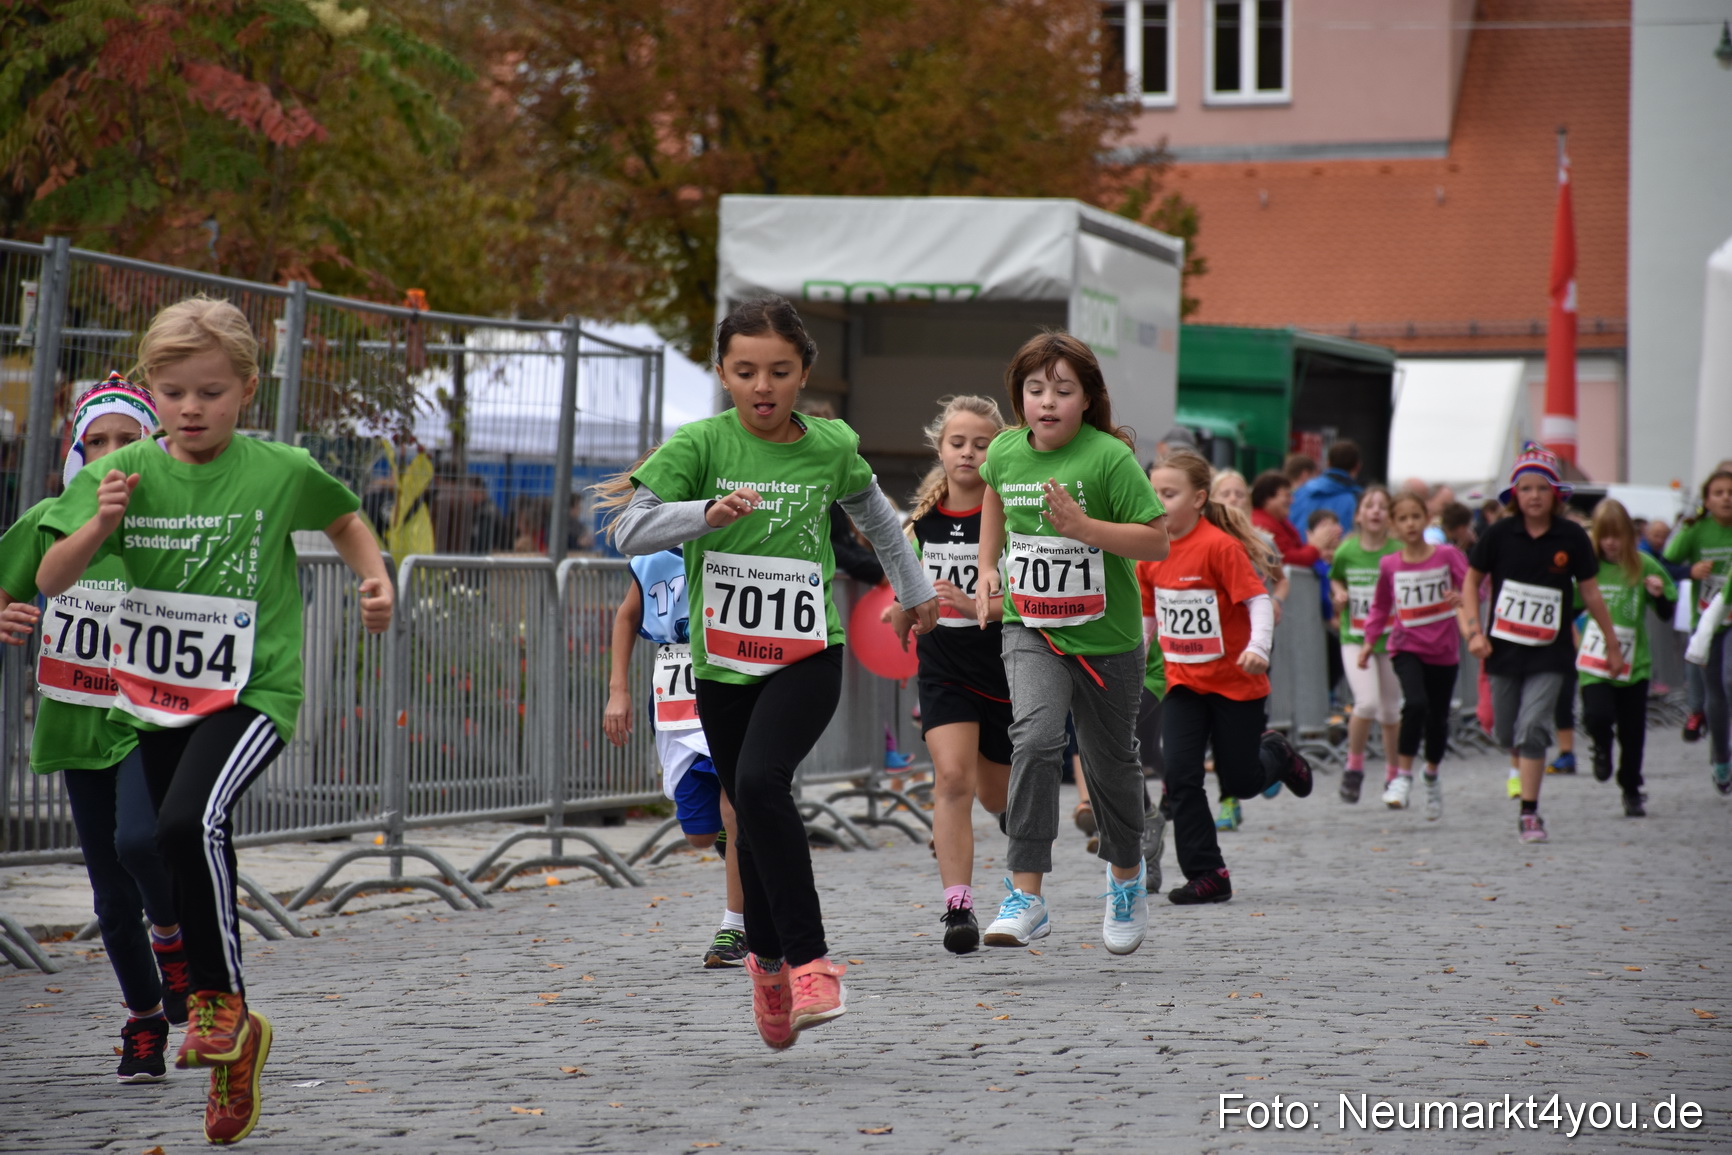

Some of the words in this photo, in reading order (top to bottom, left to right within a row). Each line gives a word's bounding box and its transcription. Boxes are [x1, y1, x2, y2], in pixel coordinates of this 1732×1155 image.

[716, 477, 802, 494] Neumarkter
[124, 514, 222, 530] Neumarkter
[124, 534, 202, 552] Stadtlauf
[246, 509, 263, 597] BAMBINI
[1036, 546, 1084, 555] Neumarkt
[924, 551, 946, 561] PARTL
[705, 563, 744, 579] PARTL
[747, 568, 805, 583] Neumarkt
[928, 564, 980, 594] 742
[1015, 556, 1091, 592] 7071
[51, 595, 82, 609] ARTL
[715, 582, 816, 633] 7016
[1023, 599, 1085, 616] Katharina
[1504, 597, 1555, 625] 7178
[155, 605, 228, 625] Neumarkt
[706, 619, 712, 627] 5
[1161, 608, 1213, 635] 7228
[815, 630, 821, 638] K
[120, 617, 237, 683] 7054
[737, 640, 783, 661] Alicia
[150, 686, 190, 712] Lara
